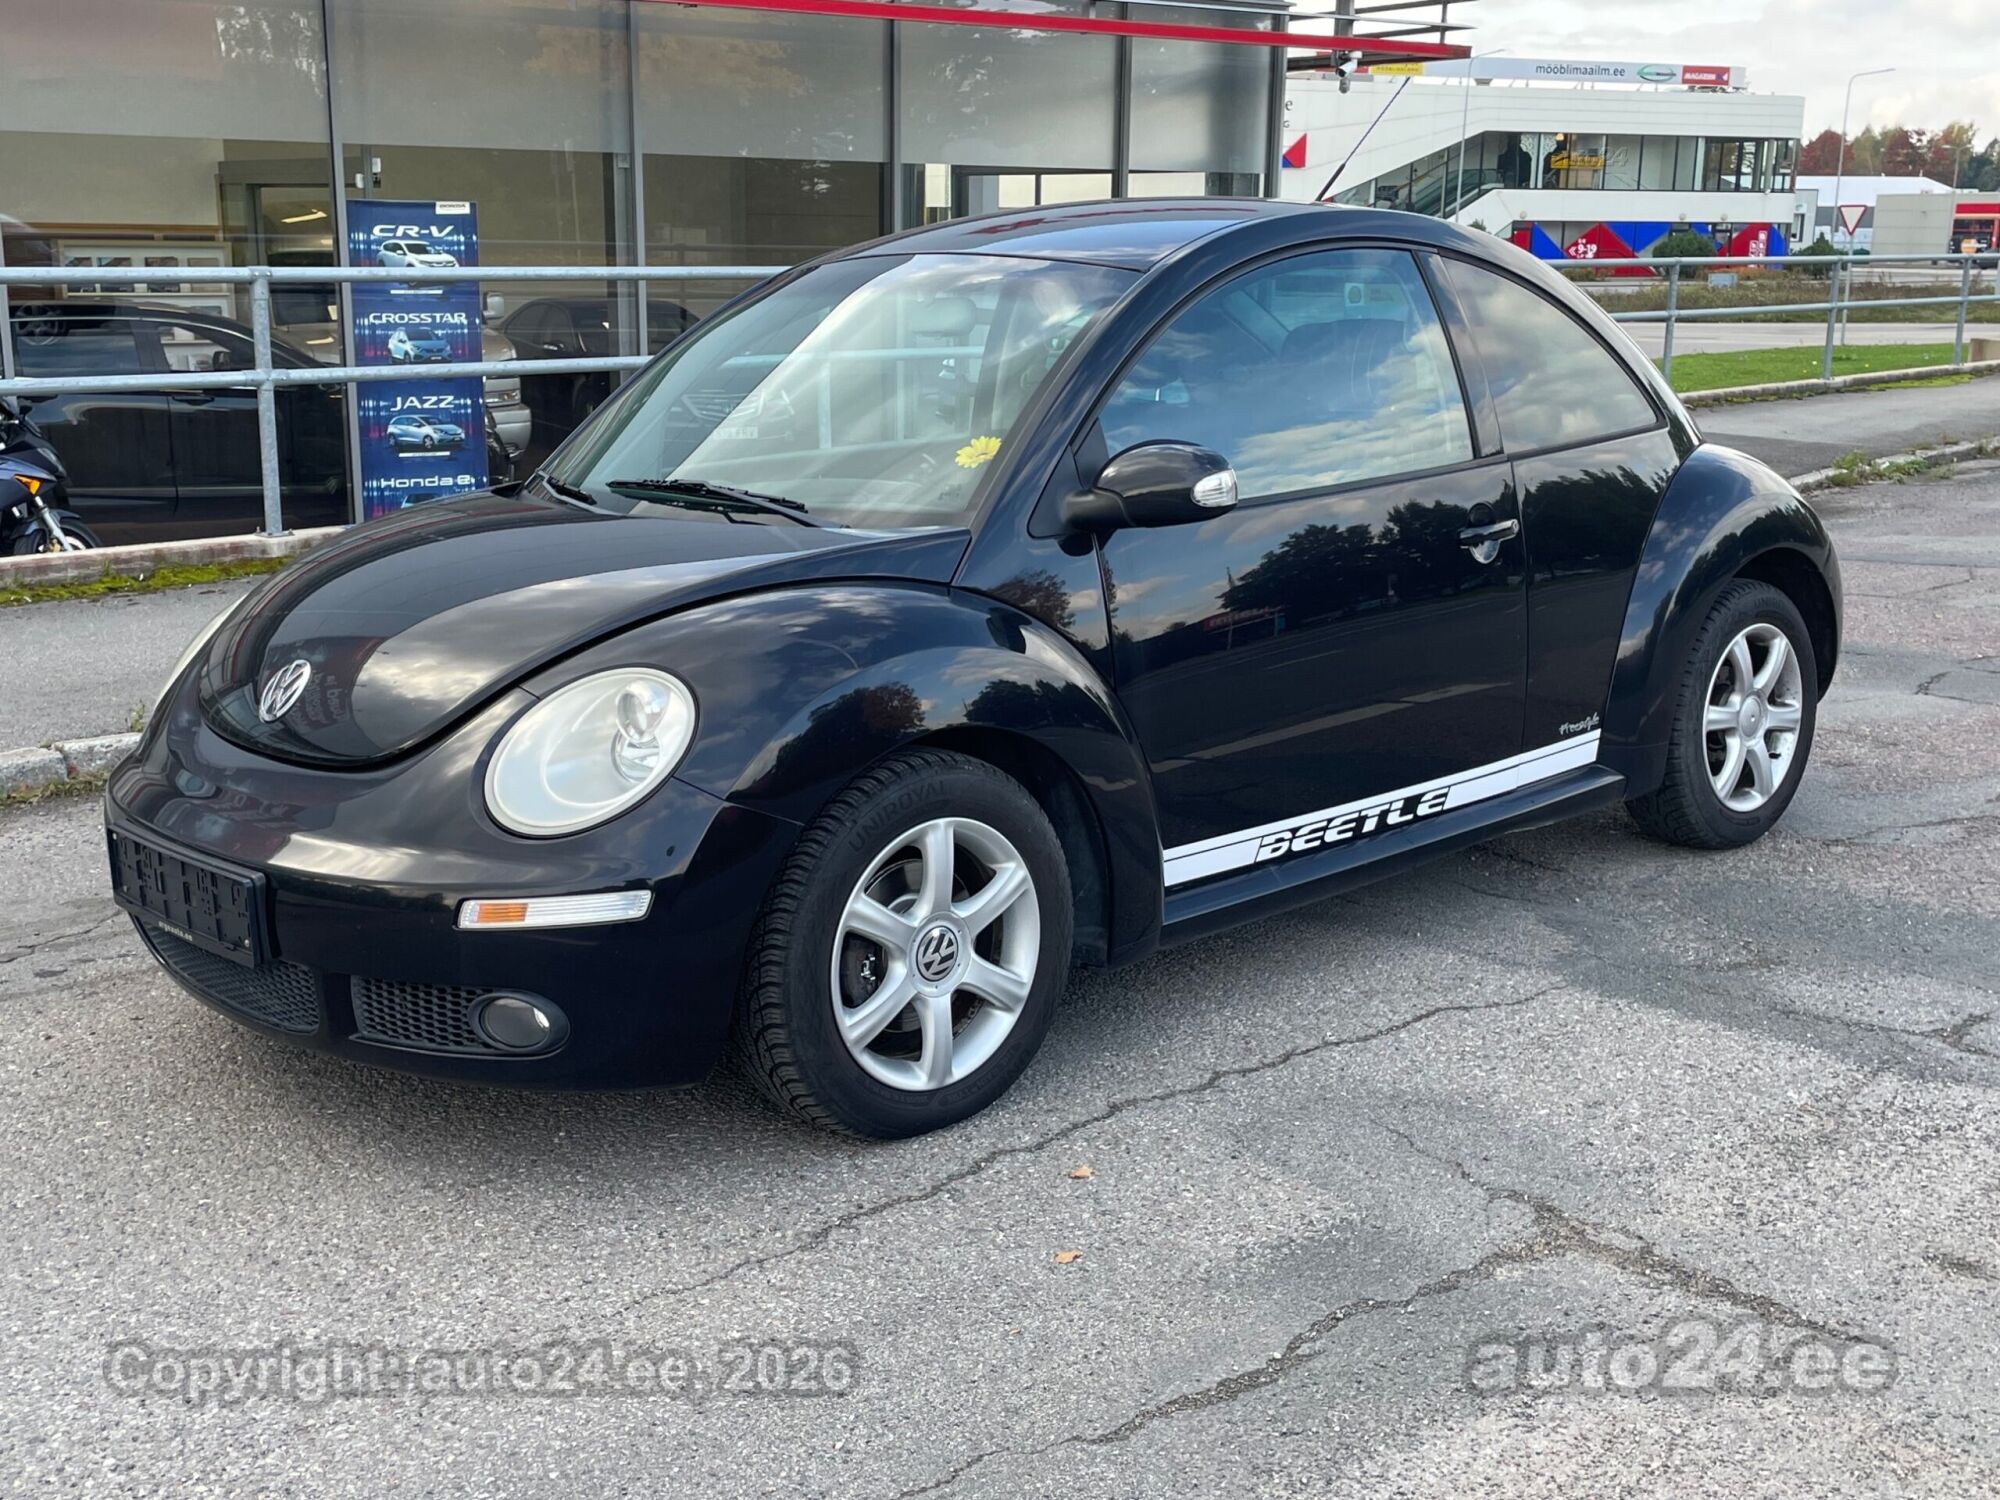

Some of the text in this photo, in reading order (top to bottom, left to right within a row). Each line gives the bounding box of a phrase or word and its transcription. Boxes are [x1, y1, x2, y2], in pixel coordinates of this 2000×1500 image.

[372, 224, 455, 237] CR-V
[369, 312, 467, 324] CROSSTAR
[390, 395, 455, 412] JAZZ
[380, 475, 453, 489] Honda
[1255, 786, 1450, 863] BEETLE
